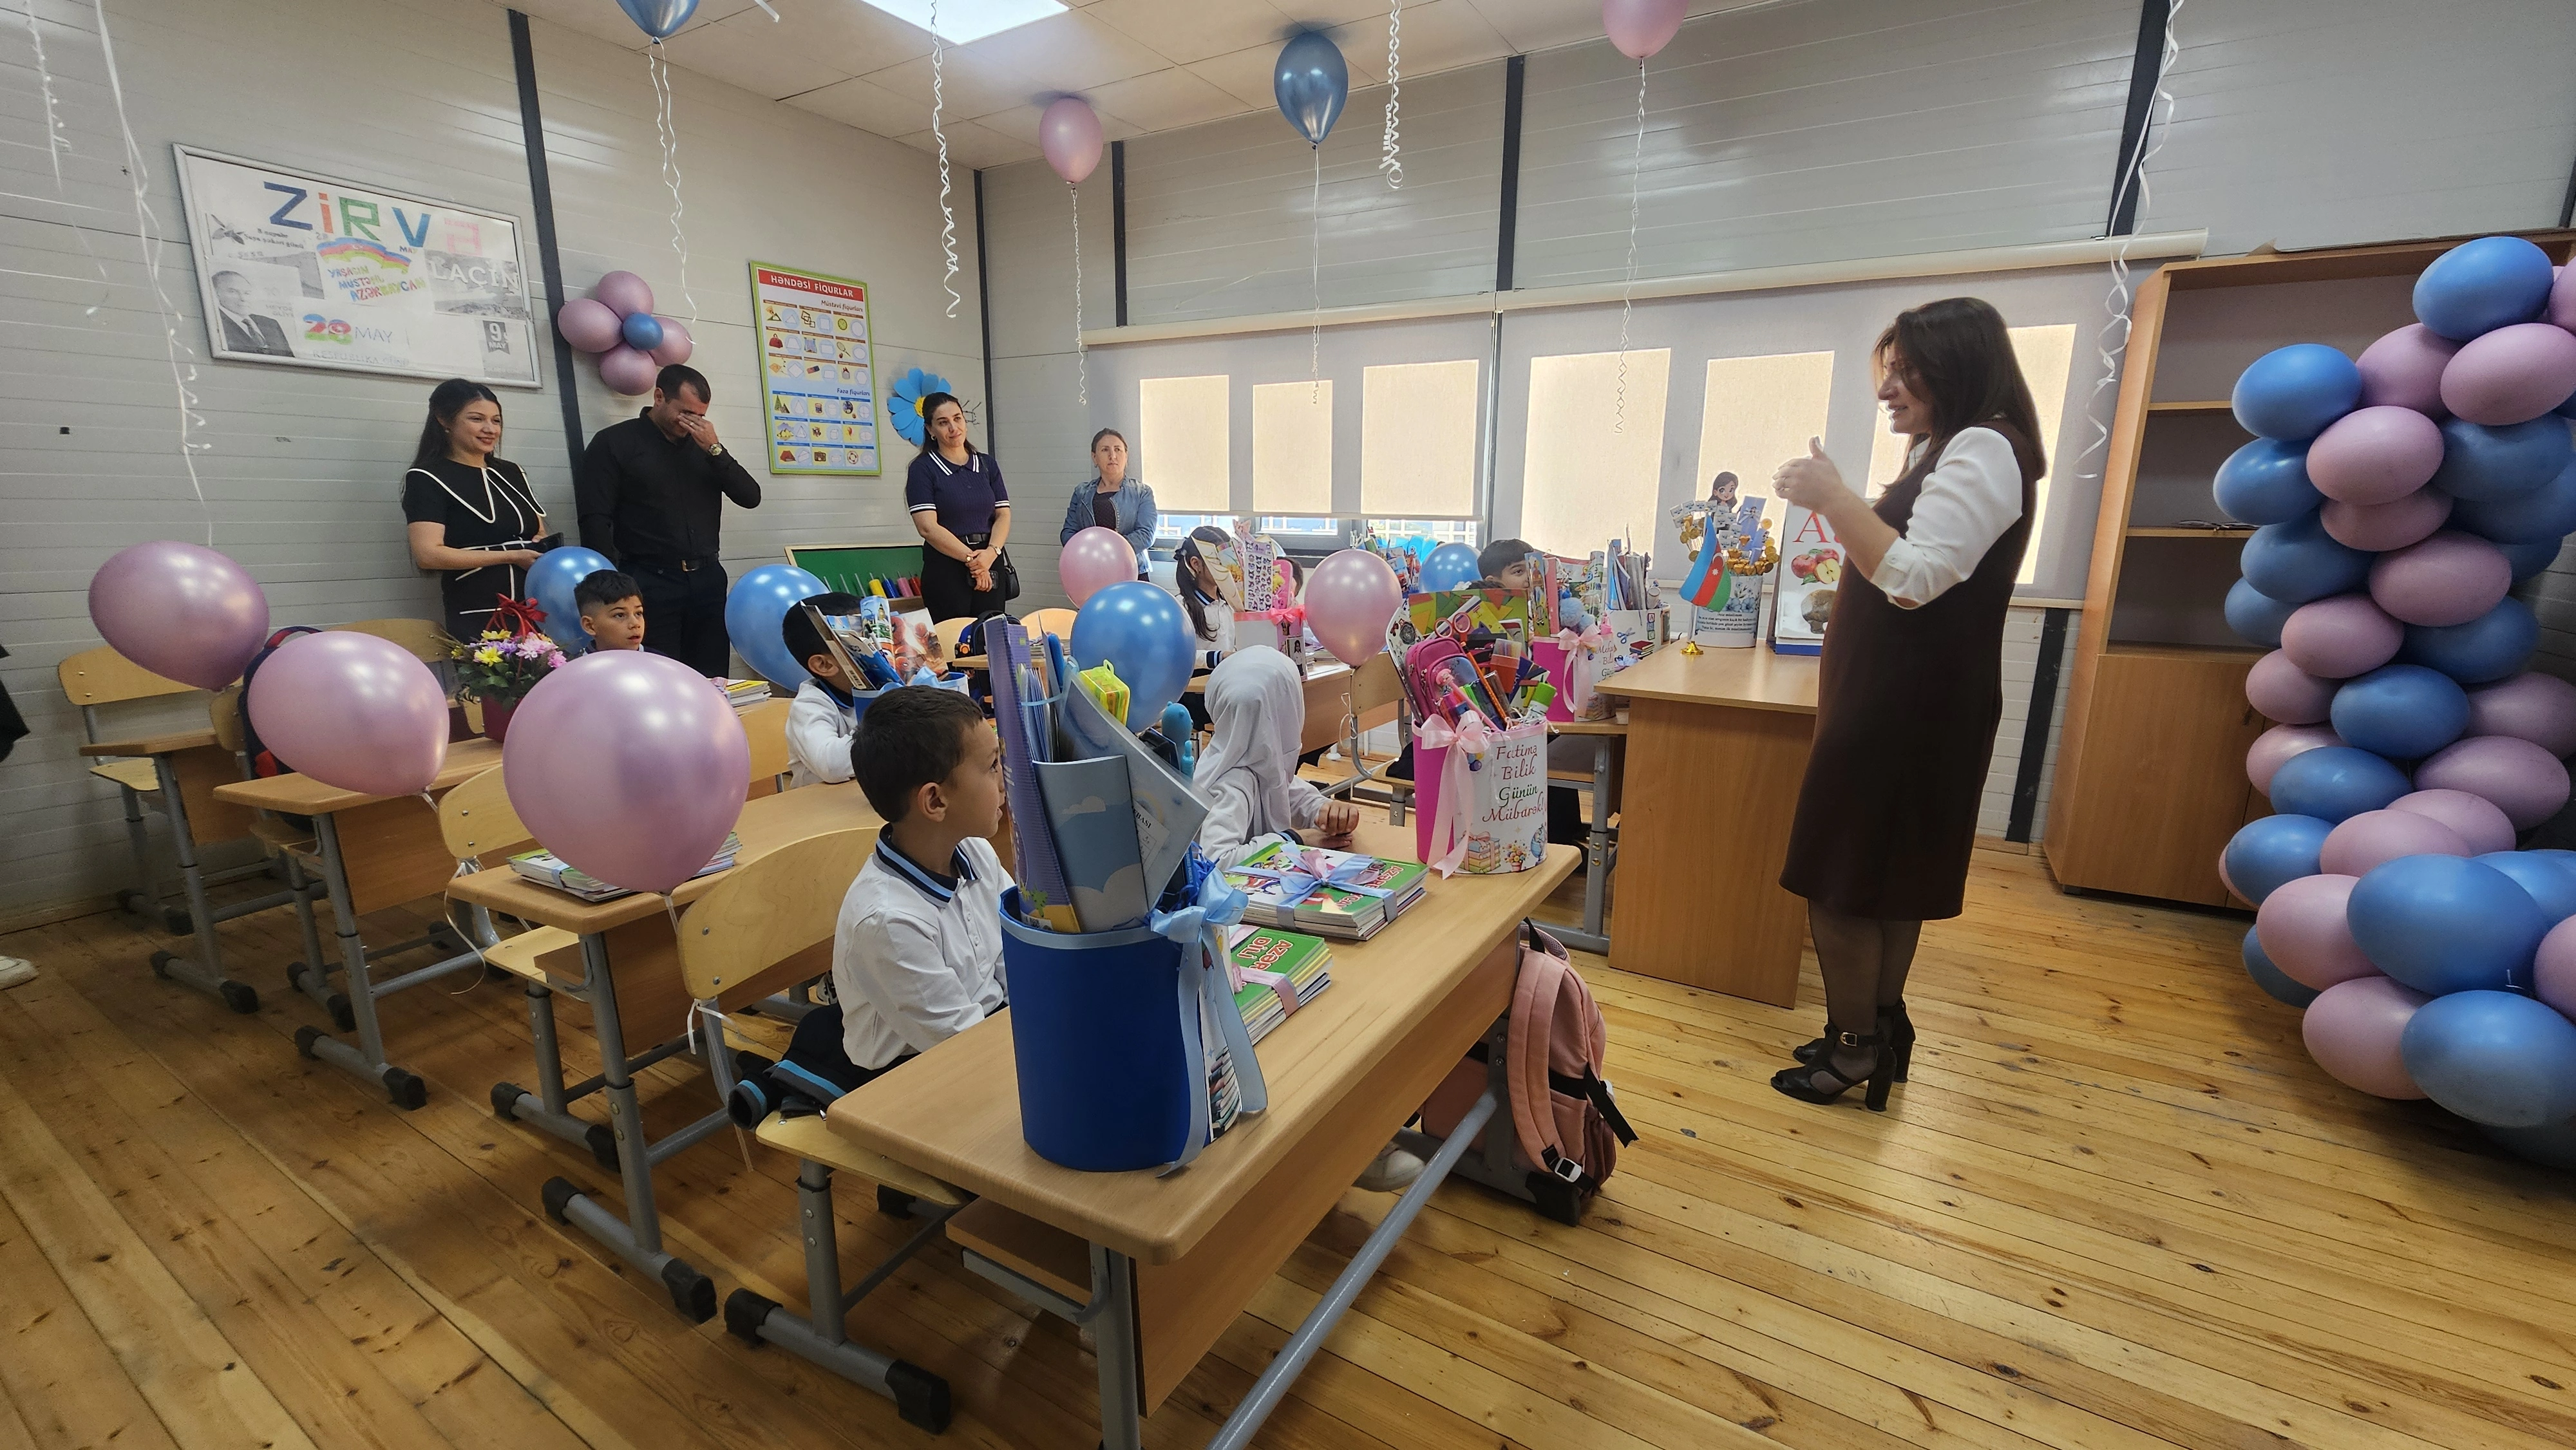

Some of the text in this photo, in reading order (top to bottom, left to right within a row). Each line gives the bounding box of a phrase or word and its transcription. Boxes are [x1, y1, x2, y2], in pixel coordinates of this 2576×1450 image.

[770, 274, 854, 297] HƏNDƏSİ FİQURLAR
[355, 326, 393, 344] MAY
[489, 323, 502, 342] 9
[1501, 753, 1538, 780] Bilik
[1499, 784, 1538, 808] Günün
[1236, 936, 1273, 959] DİLİ
[1249, 939, 1294, 971] AZƏR
